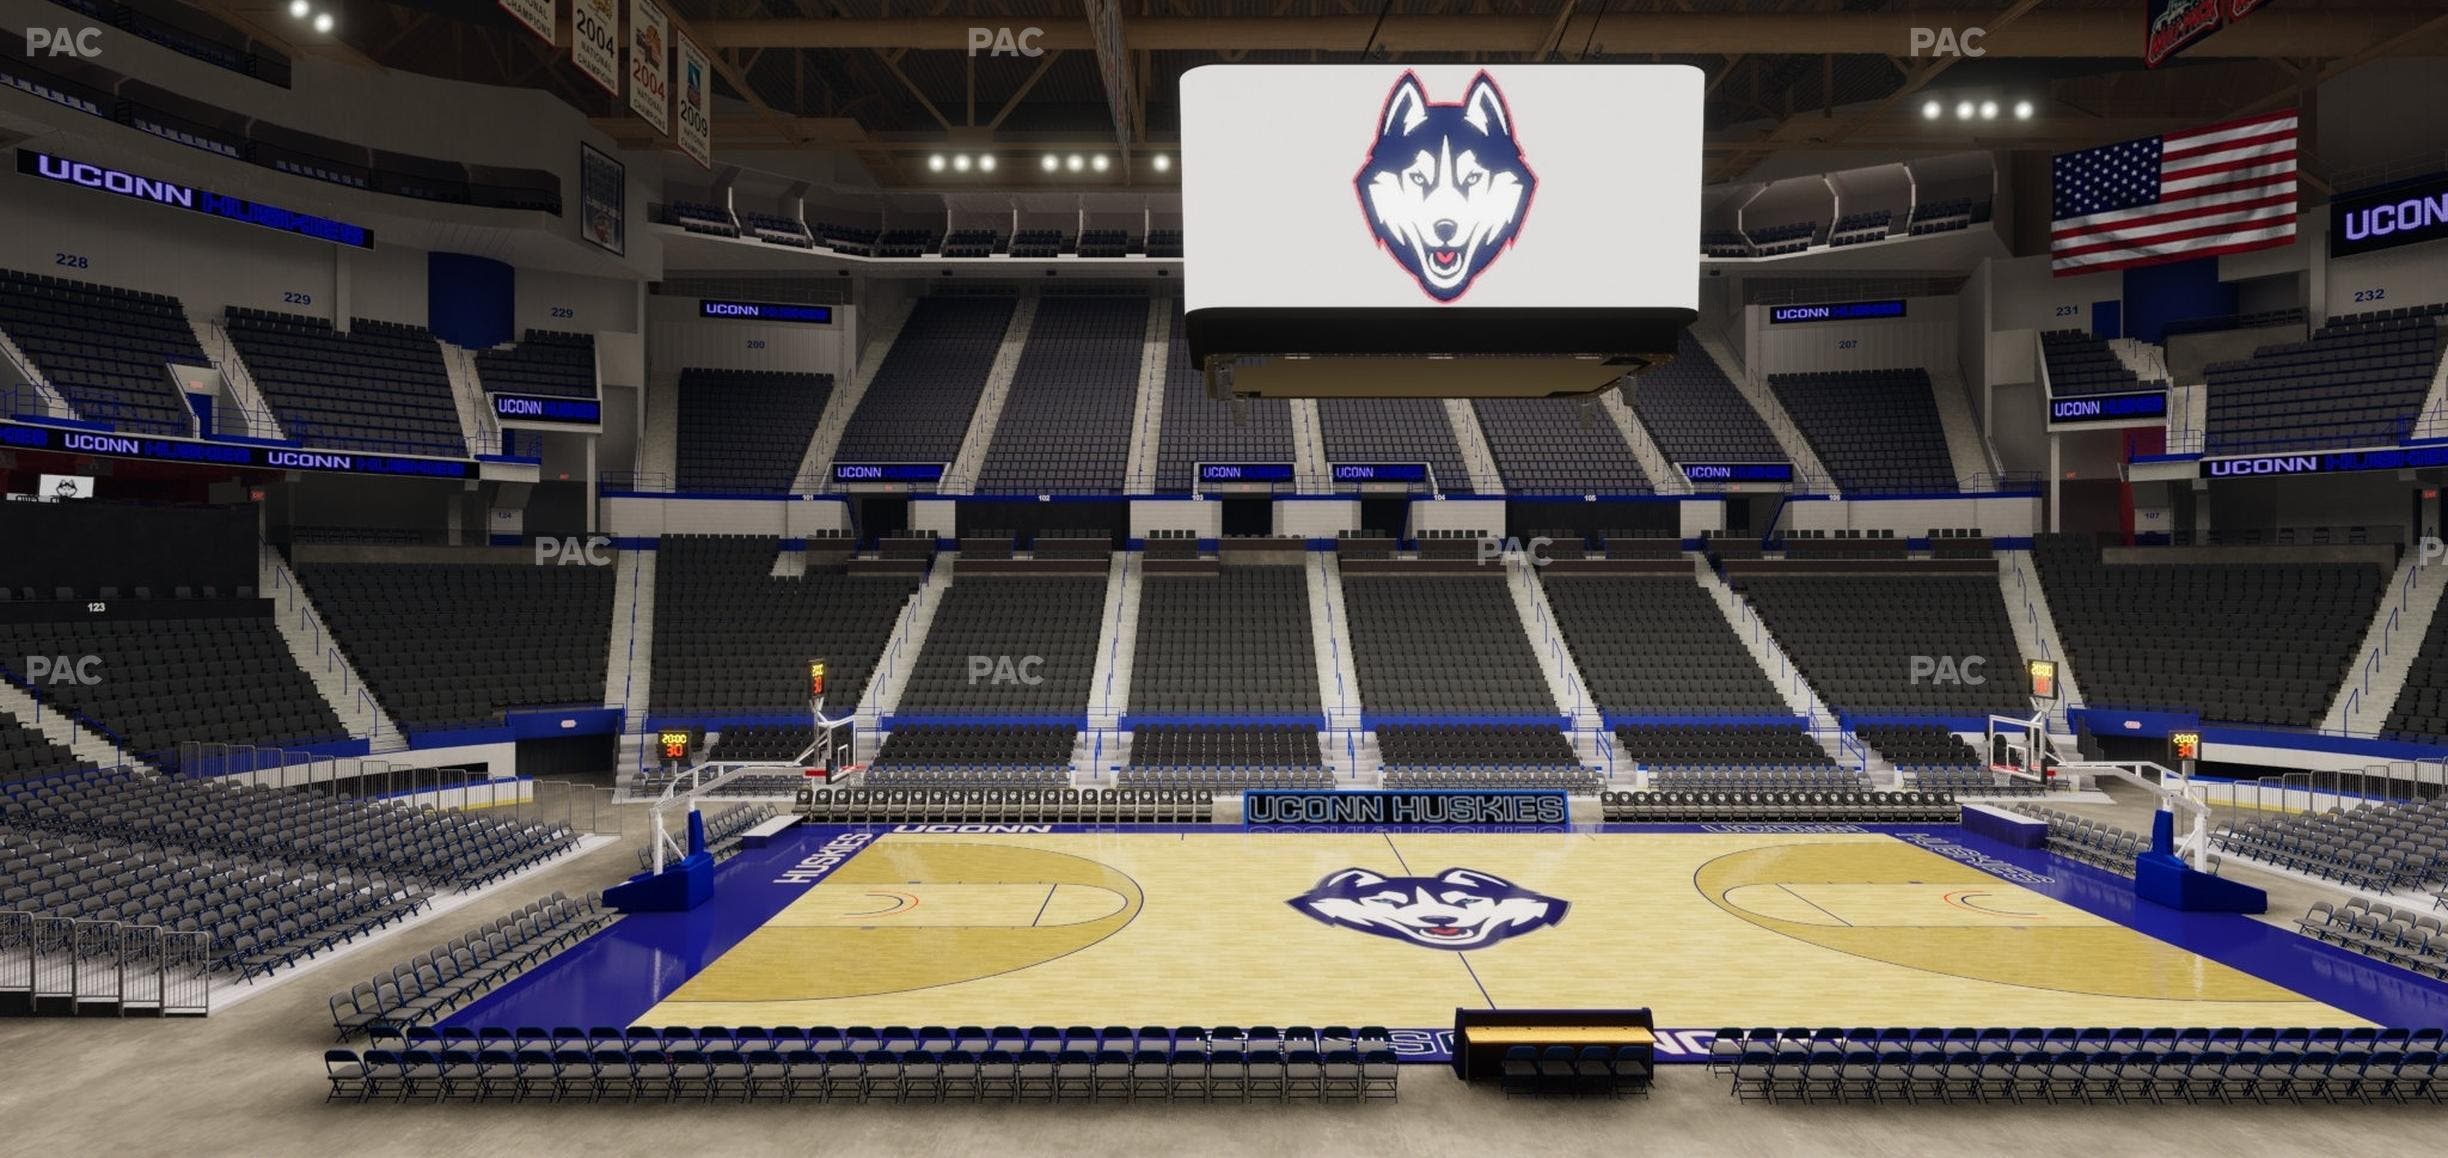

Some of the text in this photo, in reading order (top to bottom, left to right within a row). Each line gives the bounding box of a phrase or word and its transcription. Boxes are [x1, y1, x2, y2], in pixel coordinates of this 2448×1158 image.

[577, 8, 614, 59] 2004
[633, 58, 665, 101] 2004
[681, 100, 708, 138] 2009
[39, 154, 192, 207] UCONN
[55, 253, 89, 270] 228
[283, 291, 311, 306] 229
[2354, 289, 2385, 303] 232
[551, 307, 574, 319] 229
[706, 303, 759, 316] UCONN
[1775, 307, 1830, 320] UCONN
[2056, 305, 2079, 317] 231
[747, 340, 765, 349] 200
[1838, 340, 1858, 349] 207
[498, 398, 542, 415] UCONN
[2055, 400, 2100, 417] UCONN
[65, 433, 139, 454] UCONN
[268, 451, 350, 469] UCONN
[2211, 455, 2318, 476] UCONN
[837, 467, 882, 478] UCONN
[1203, 465, 1242, 479] UCONN
[1335, 465, 1375, 479] UCONN
[1685, 466, 1731, 479] UCONN
[88, 602, 106, 612] 123
[661, 733, 687, 744] 20:00
[2172, 733, 2199, 745] 20:00
[666, 744, 683, 757] 30
[2177, 744, 2194, 757] 30
[1249, 796, 1567, 823] UCONN HUSKIES
[893, 825, 1053, 834] UCONN
[773, 832, 874, 884] HUSKIES
